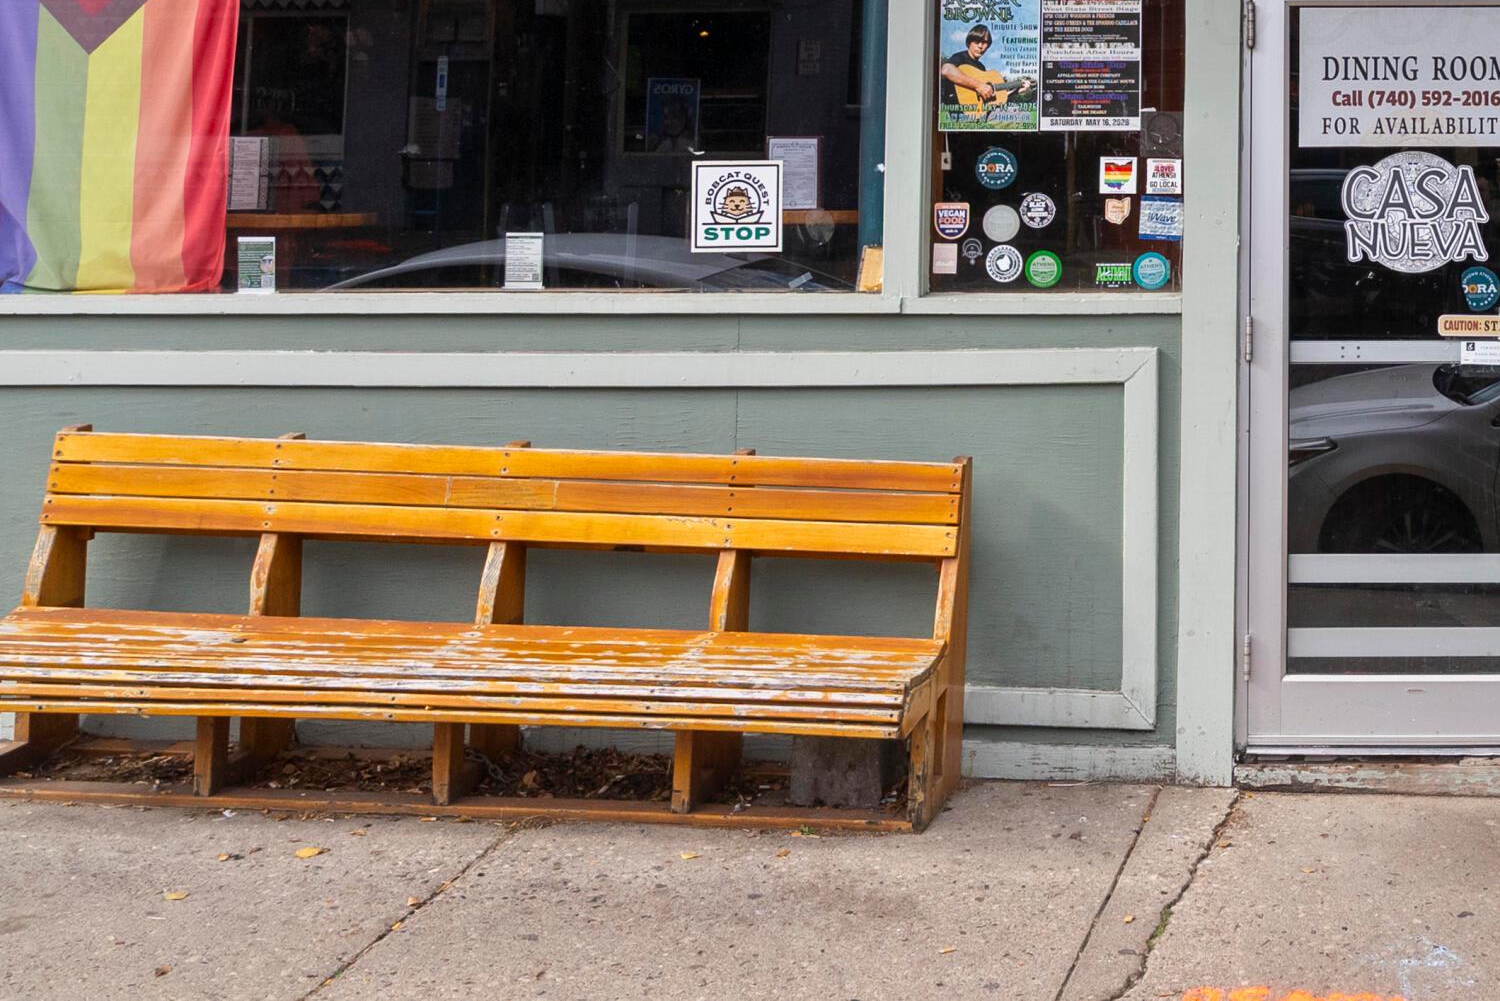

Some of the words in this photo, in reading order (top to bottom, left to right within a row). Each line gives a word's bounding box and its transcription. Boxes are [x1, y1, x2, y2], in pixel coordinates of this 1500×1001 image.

[944, 7, 1014, 23] BROWNE
[1322, 56, 1418, 81] DINING
[1331, 90, 1363, 107] Call
[1368, 90, 1416, 109] (740)
[1421, 90, 1500, 107] 592-2016
[1322, 117, 1361, 134] FOR
[705, 171, 741, 205] BOBCAT
[743, 172, 770, 206] QUEST
[1342, 165, 1490, 223] CASA
[704, 226, 770, 240] STOP
[1344, 219, 1489, 262] NUEVA
[1443, 320, 1482, 332] CAUTION:
